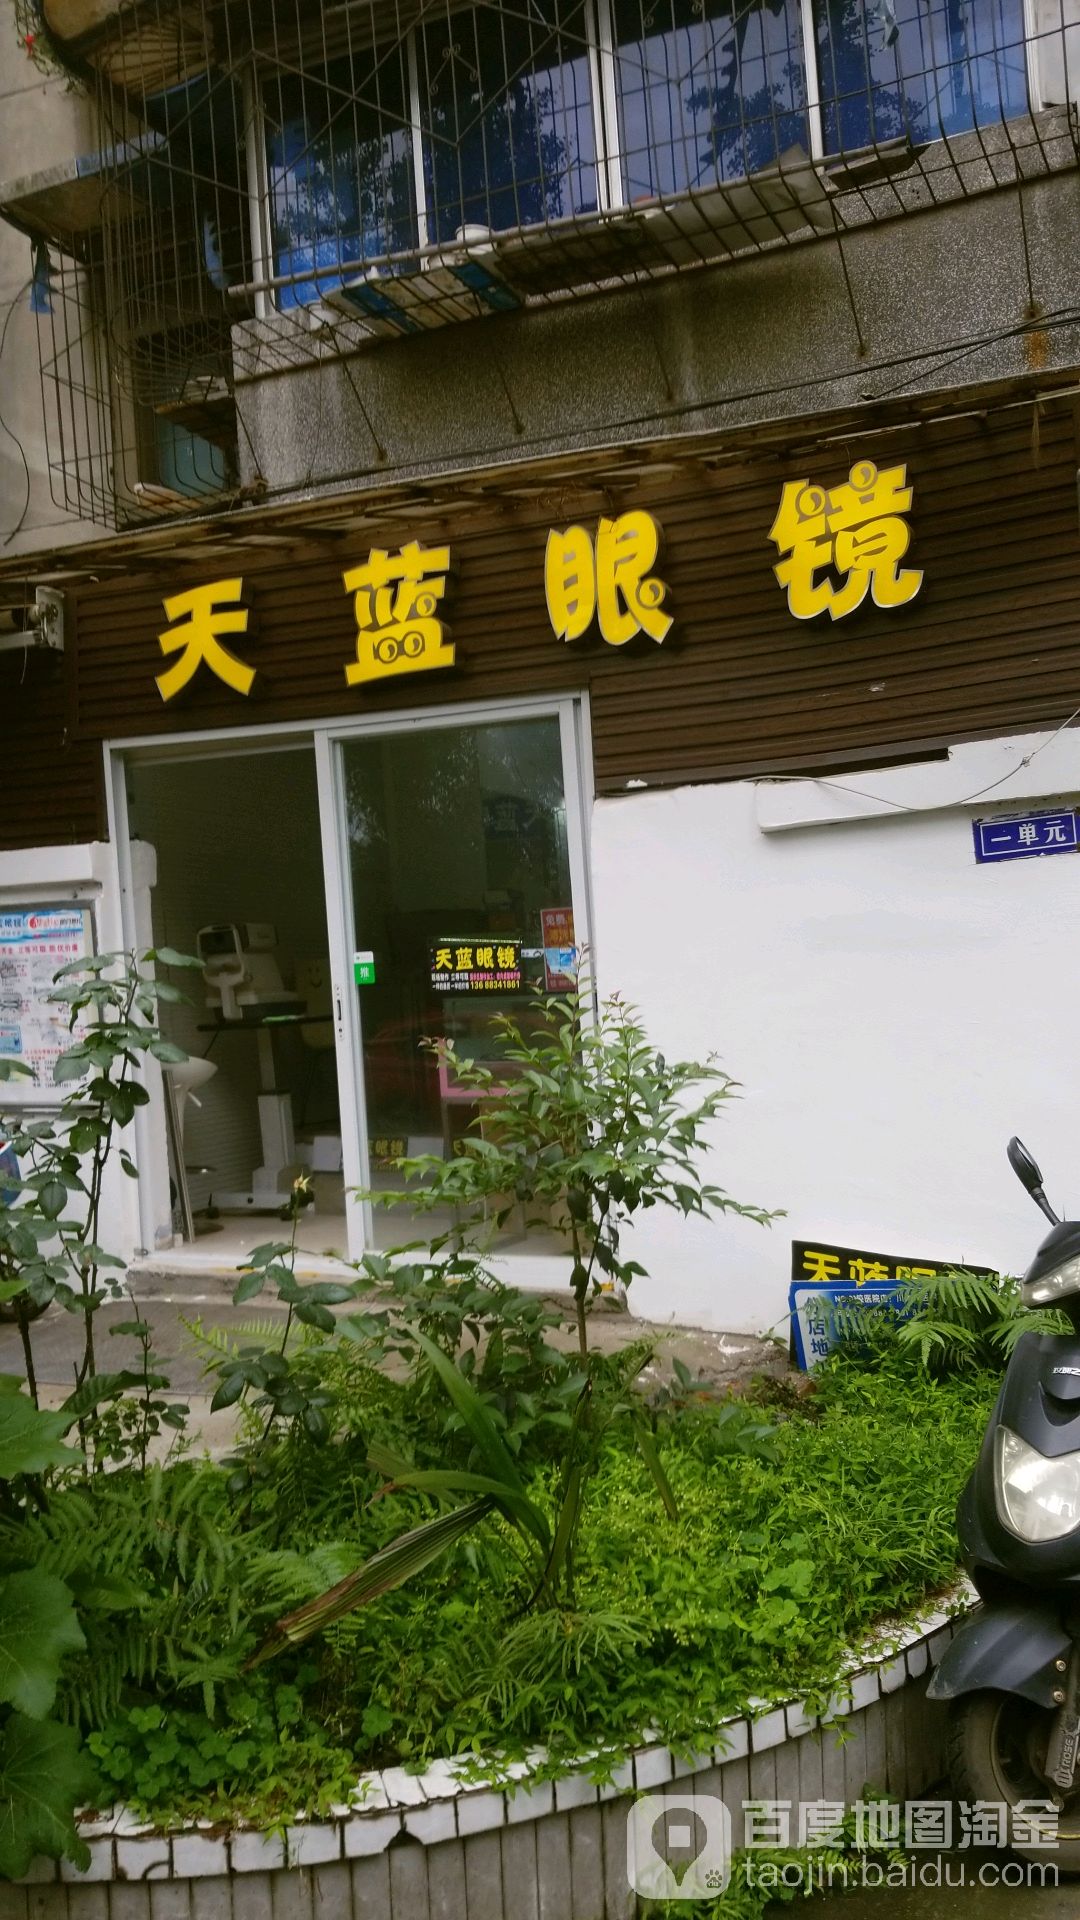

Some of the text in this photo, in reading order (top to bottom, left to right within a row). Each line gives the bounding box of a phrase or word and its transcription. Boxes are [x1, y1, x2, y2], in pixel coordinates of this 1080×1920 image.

[154, 460, 925, 703] 天蓝眼镜
[990, 820, 1067, 846] 一单元
[435, 945, 516, 971] 天蓝眼镜
